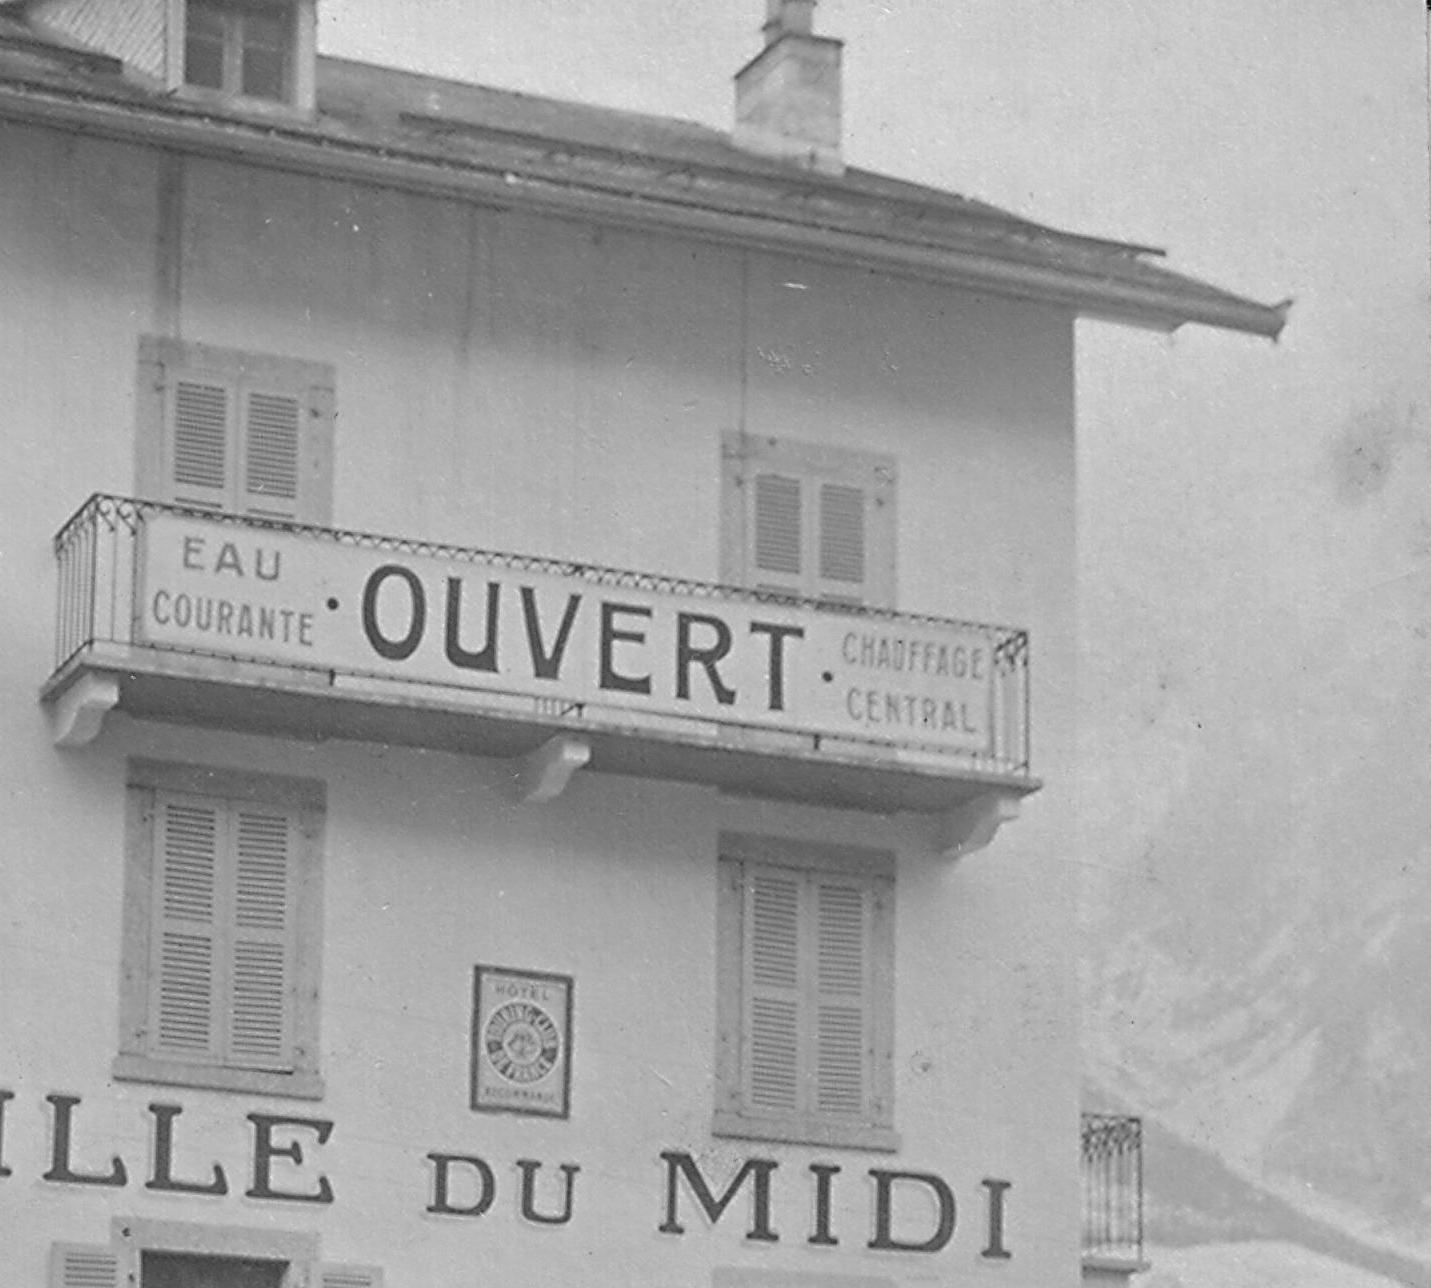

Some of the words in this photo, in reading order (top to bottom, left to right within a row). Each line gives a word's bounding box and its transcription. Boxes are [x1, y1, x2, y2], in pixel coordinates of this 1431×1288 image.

[182, 534, 281, 581] EAU
[152, 590, 315, 646] COURANTE
[361, 563, 804, 711] OUVERT
[842, 631, 984, 680] CHAUFFAGE
[847, 686, 978, 734] CENTRAL
[425, 1152, 581, 1225] DU
[658, 1151, 1012, 1260] MIDI
